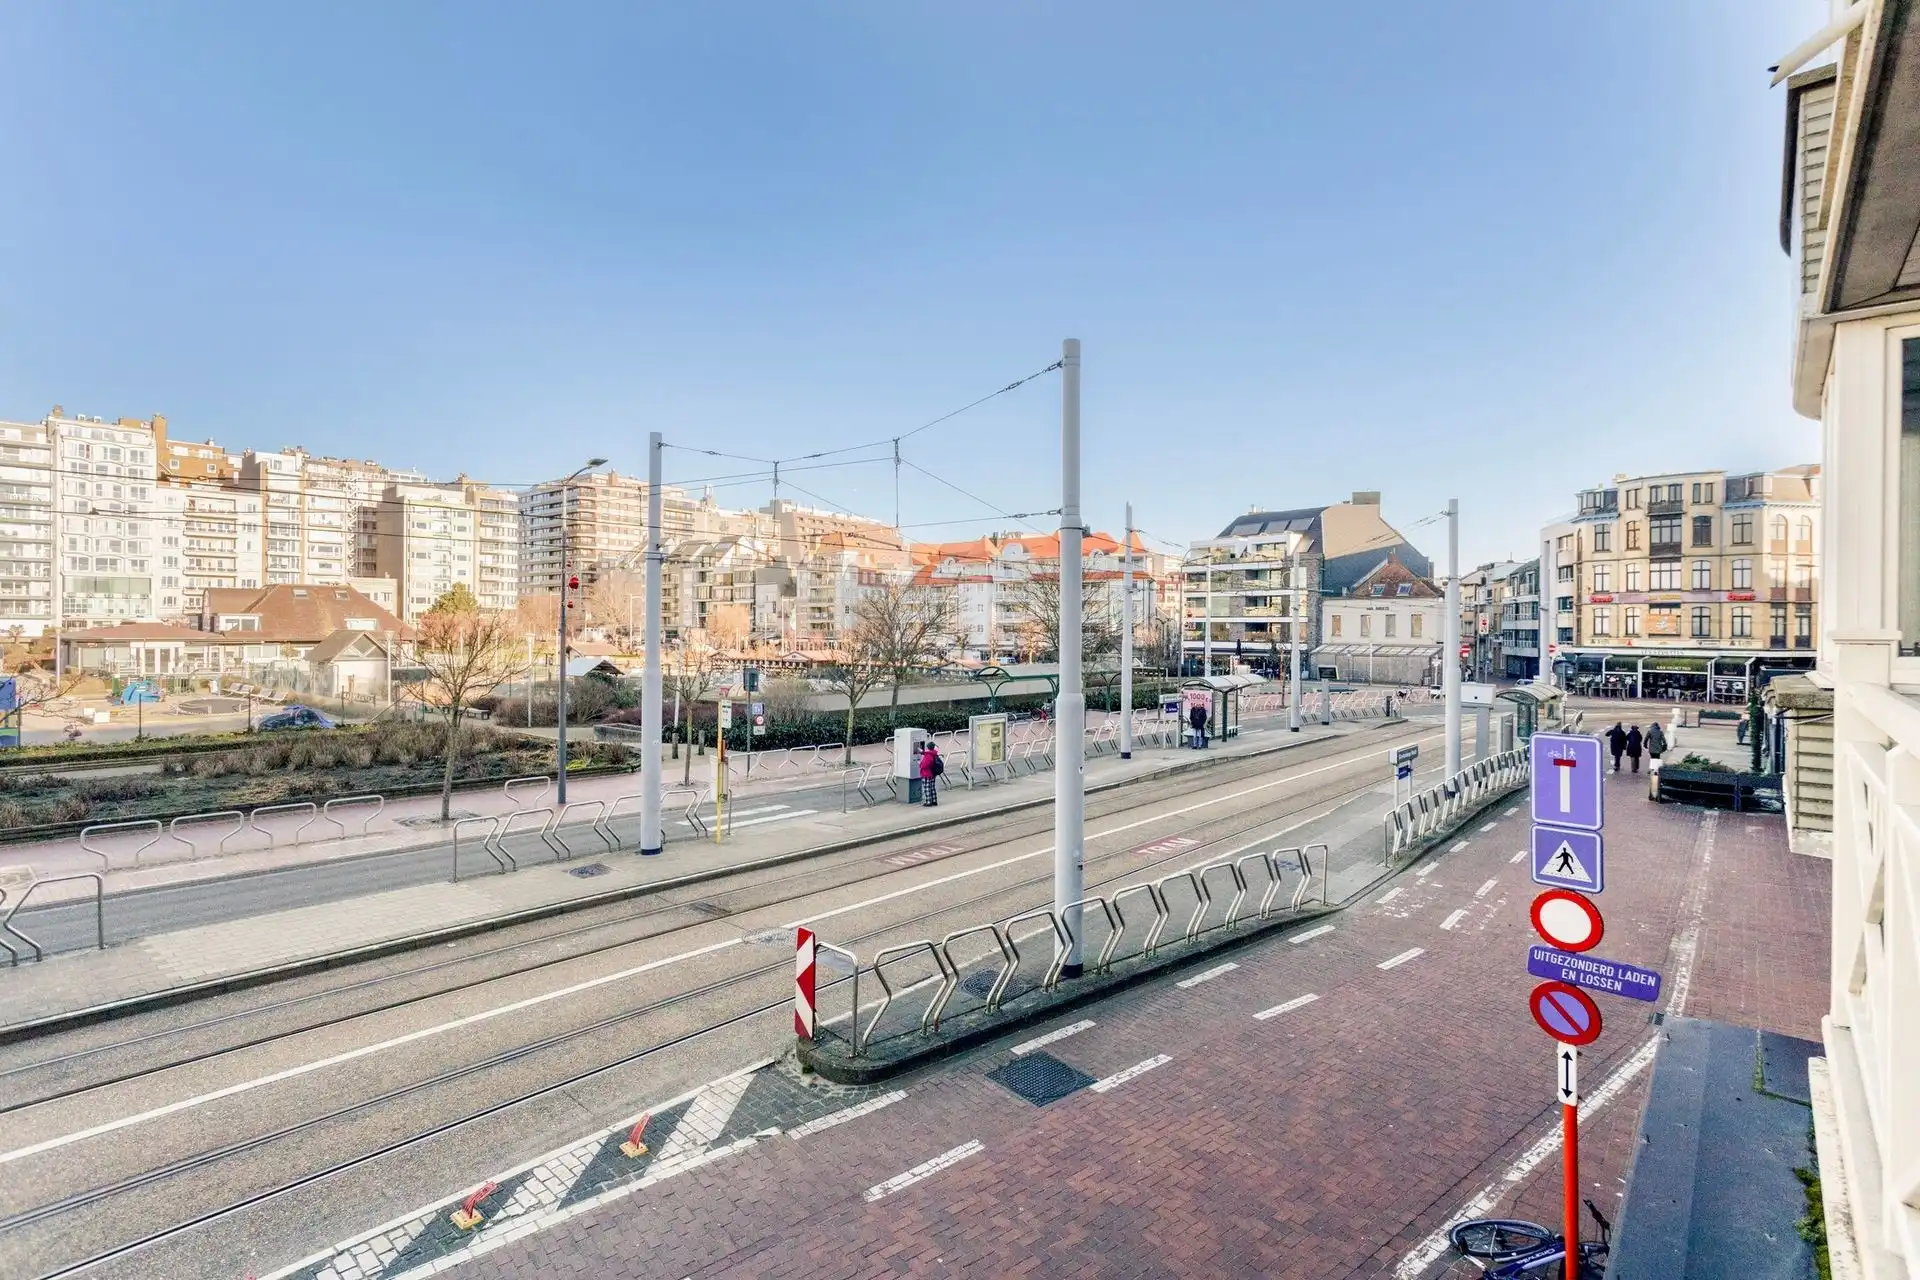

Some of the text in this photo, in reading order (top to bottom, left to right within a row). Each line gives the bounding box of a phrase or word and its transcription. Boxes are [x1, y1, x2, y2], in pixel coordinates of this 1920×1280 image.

[884, 844, 965, 865] TRAM
[1533, 949, 1656, 987] UITGEZONDERD LADEN
[1561, 968, 1623, 991] EN LOSSEN
